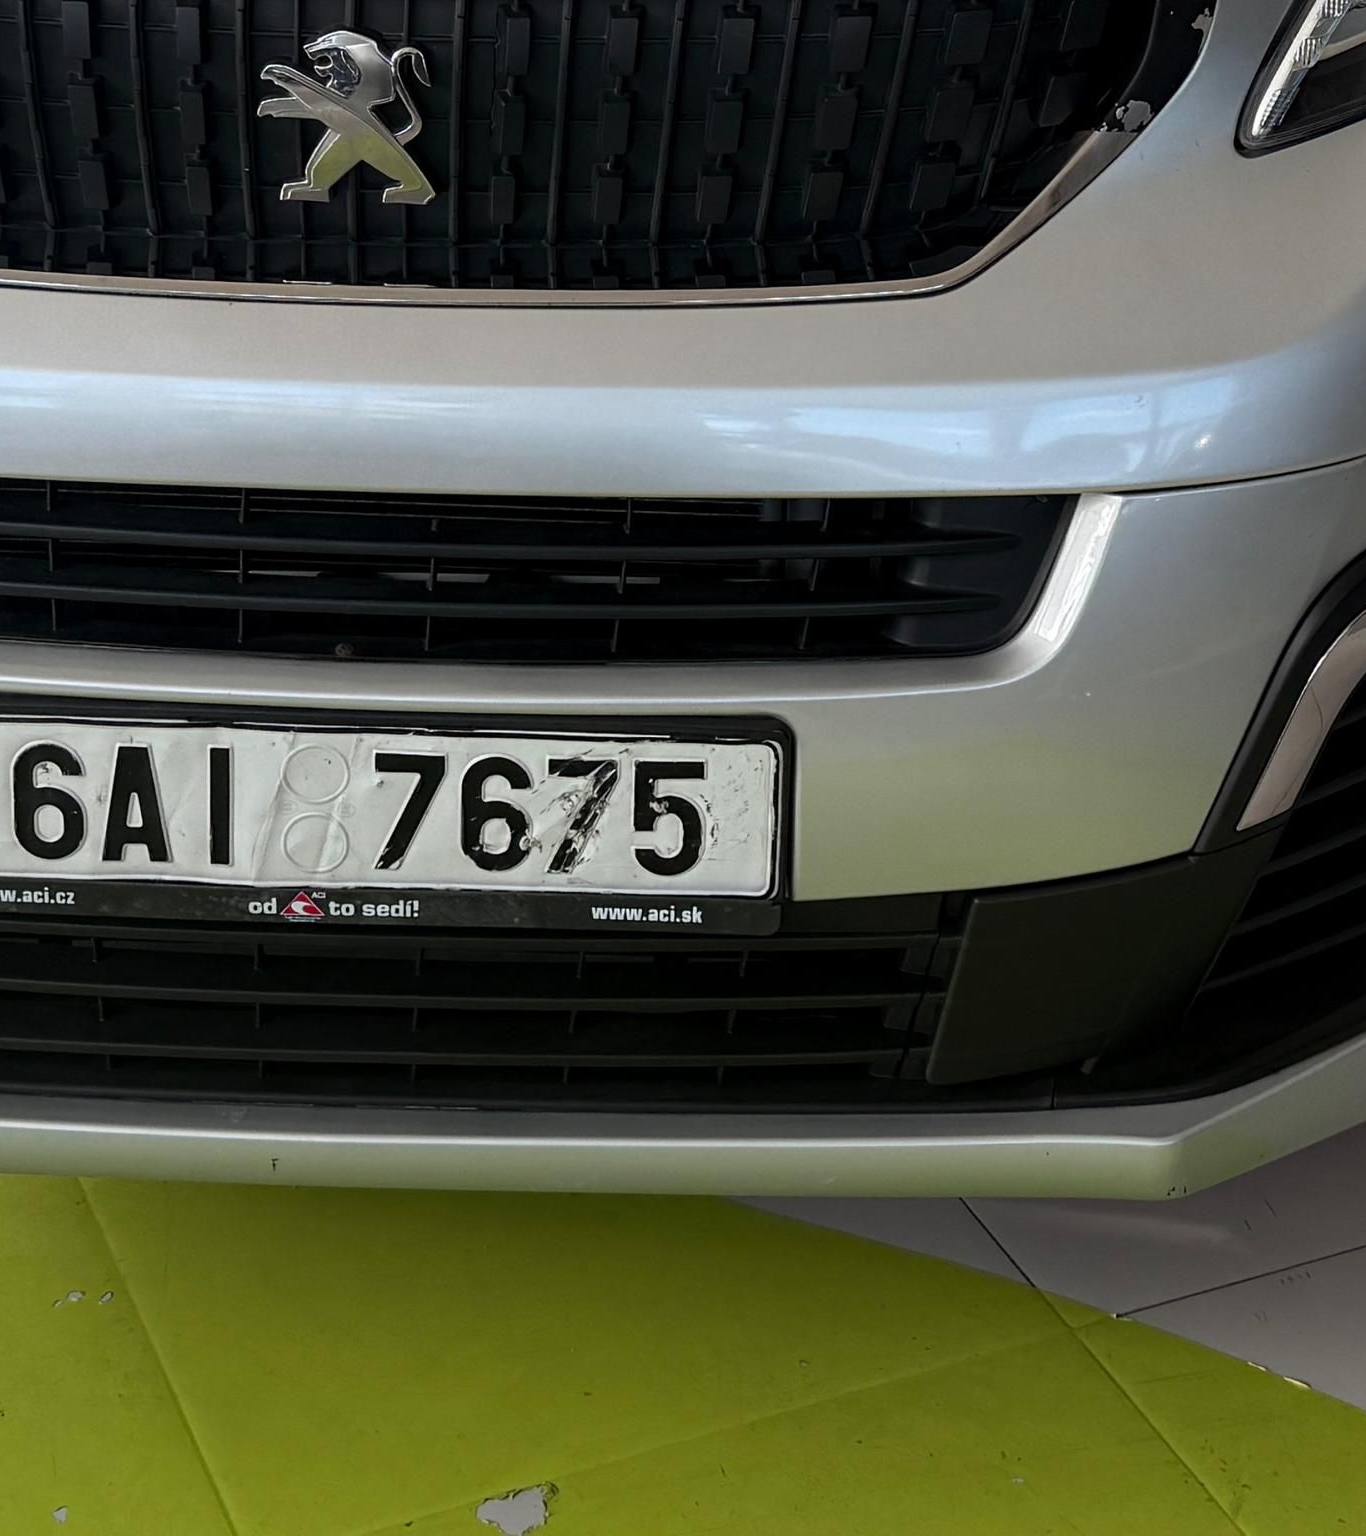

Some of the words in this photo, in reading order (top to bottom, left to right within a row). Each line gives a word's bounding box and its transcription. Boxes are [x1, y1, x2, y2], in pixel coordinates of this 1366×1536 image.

[373, 749, 709, 877] 7675
[248, 897, 277, 915] od
[328, 900, 355, 917] to
[361, 900, 420, 918] sedí!
[591, 904, 703, 925] www.aci.sk
